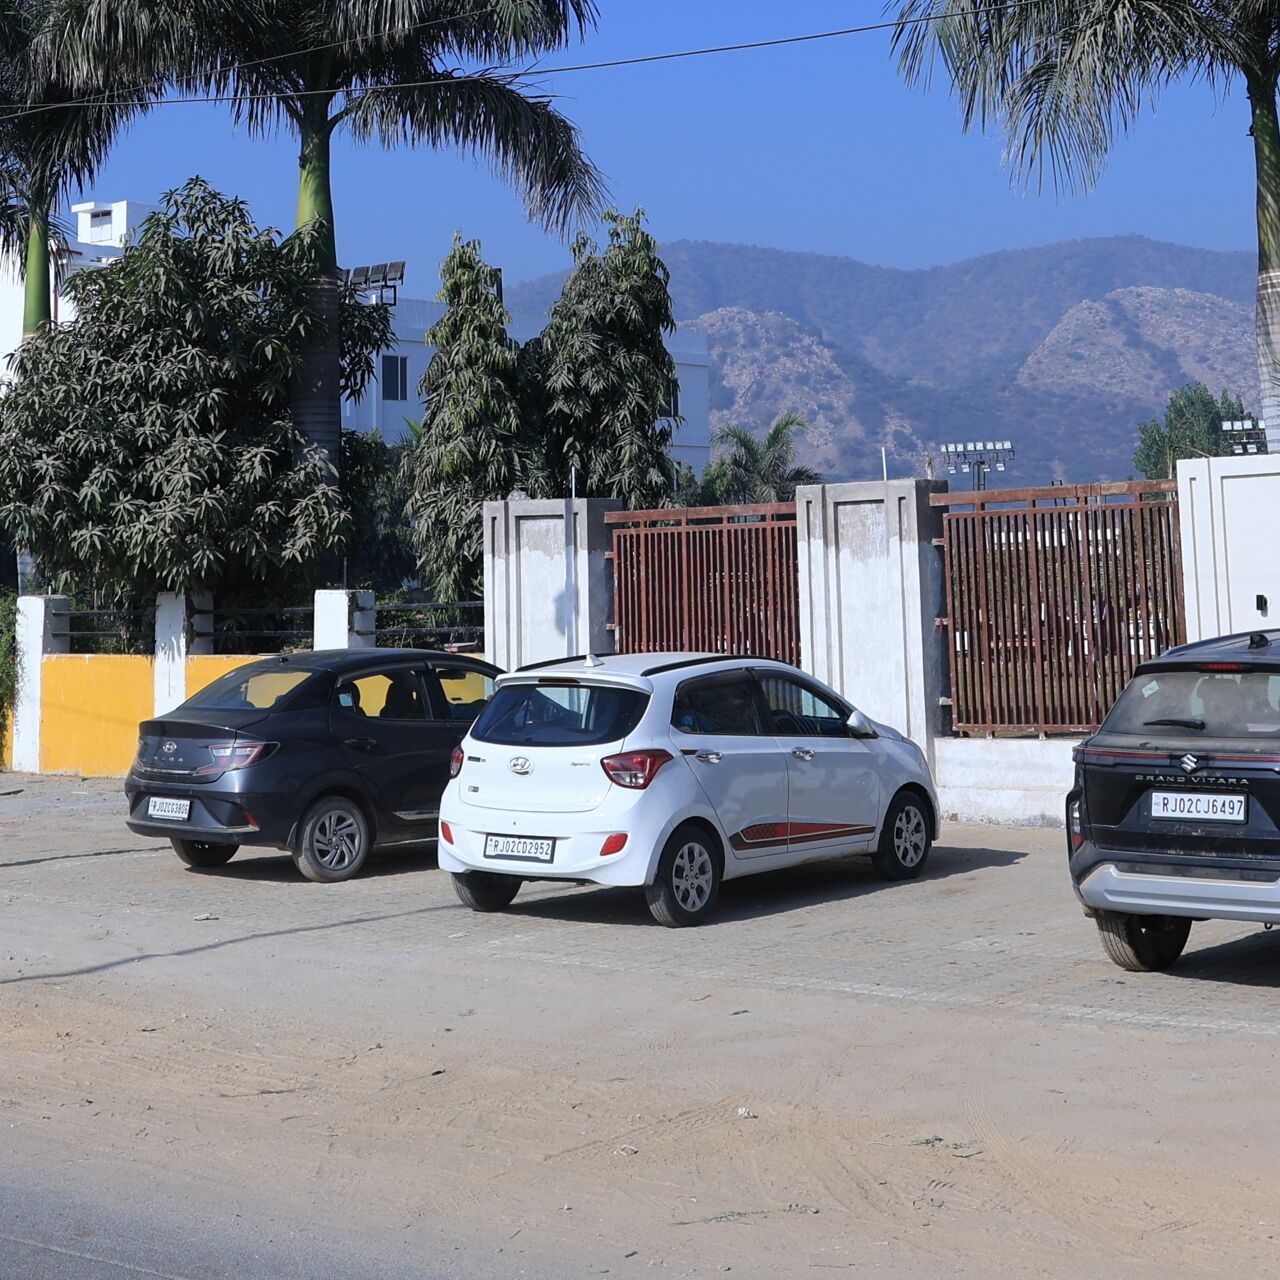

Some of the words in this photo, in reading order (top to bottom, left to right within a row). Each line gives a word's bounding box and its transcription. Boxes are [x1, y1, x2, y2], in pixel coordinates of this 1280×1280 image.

[1191, 777, 1250, 785] VITARA
[1162, 798, 1244, 816] RJ02CJ6497
[493, 839, 551, 856] RJ02CD2952
